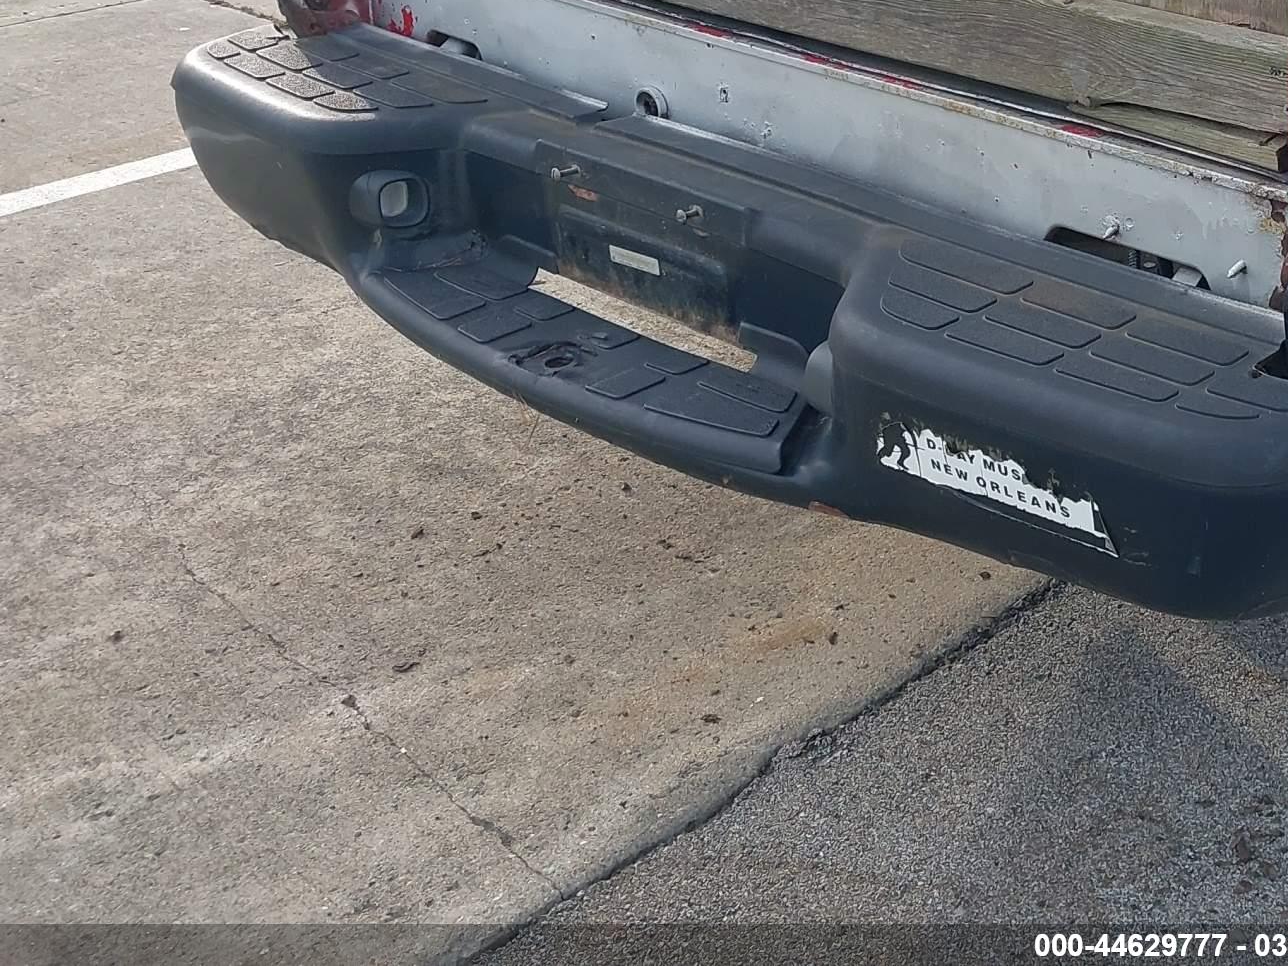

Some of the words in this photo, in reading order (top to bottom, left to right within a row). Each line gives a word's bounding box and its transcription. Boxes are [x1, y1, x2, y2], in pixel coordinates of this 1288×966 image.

[926, 437, 976, 465] D-AY
[930, 458, 969, 482] NEW
[975, 475, 1071, 519] ORLEANS
